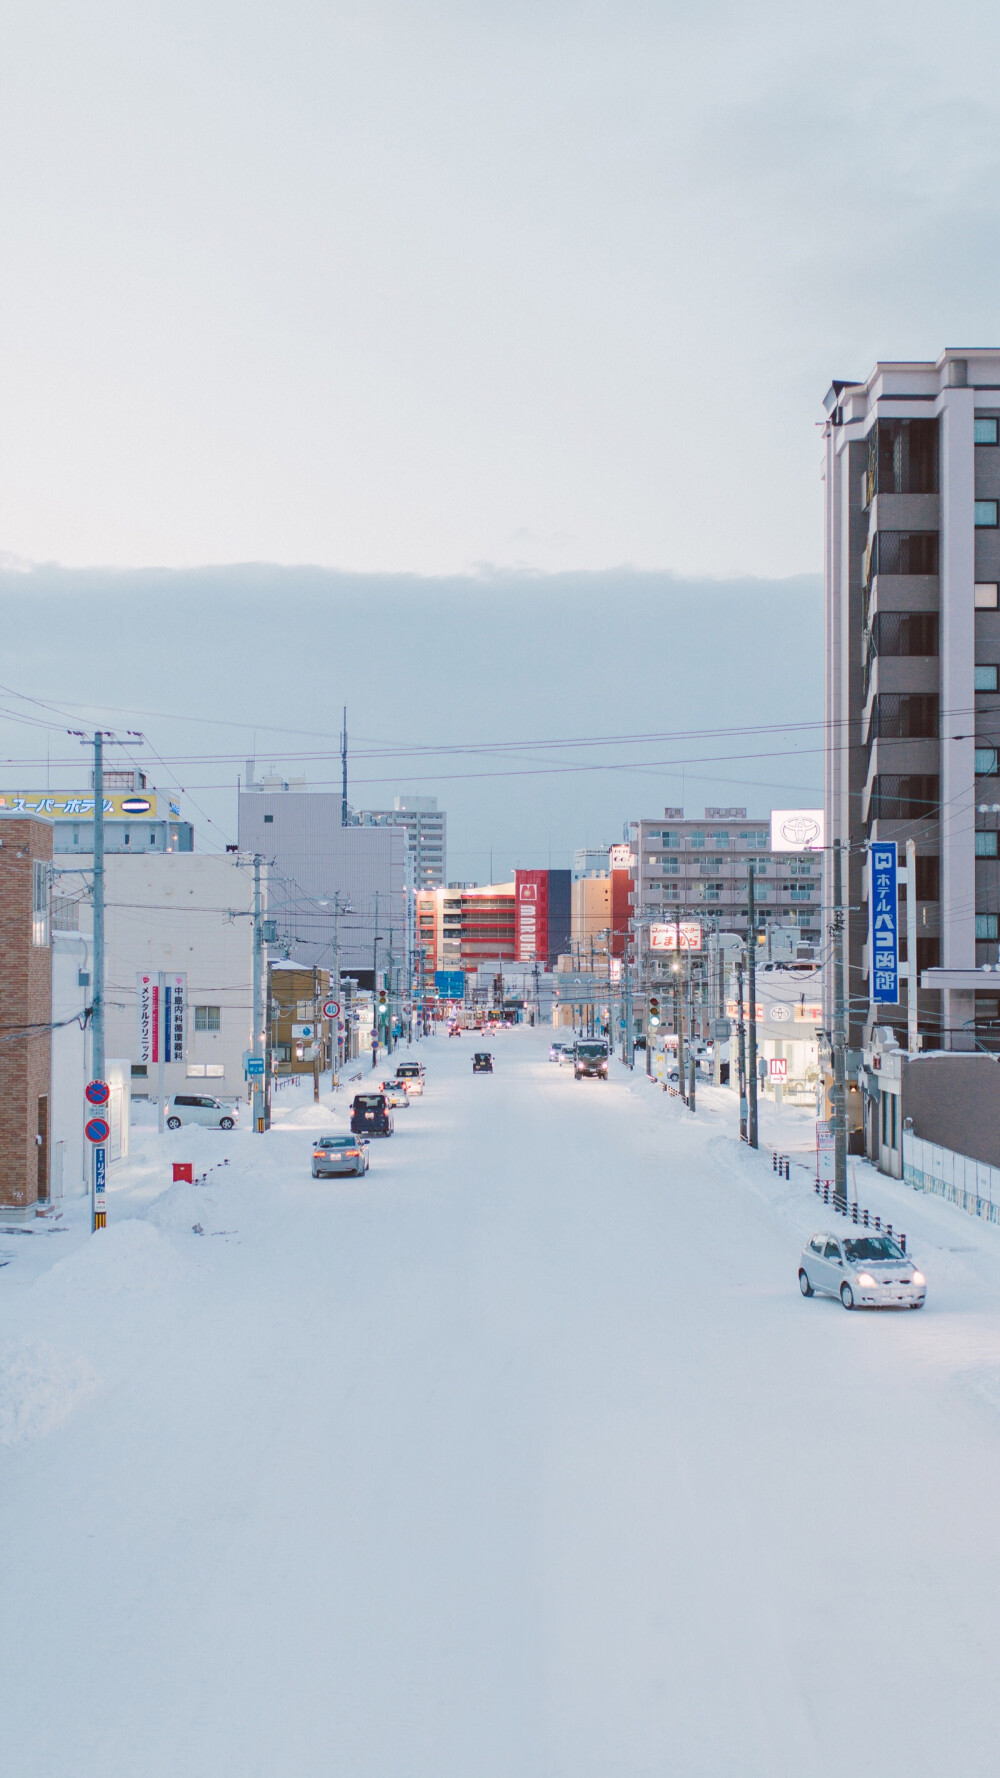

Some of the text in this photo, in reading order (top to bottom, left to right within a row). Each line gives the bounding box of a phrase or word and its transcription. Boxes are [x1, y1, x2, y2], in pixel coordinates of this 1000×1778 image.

[11, 798, 114, 814] スーパーホテル
[874, 873, 895, 990] ホテルパコ函館
[326, 1005, 337, 1014] 40
[141, 986, 150, 1061] メンタルクリニック
[771, 1060, 786, 1074] IN
